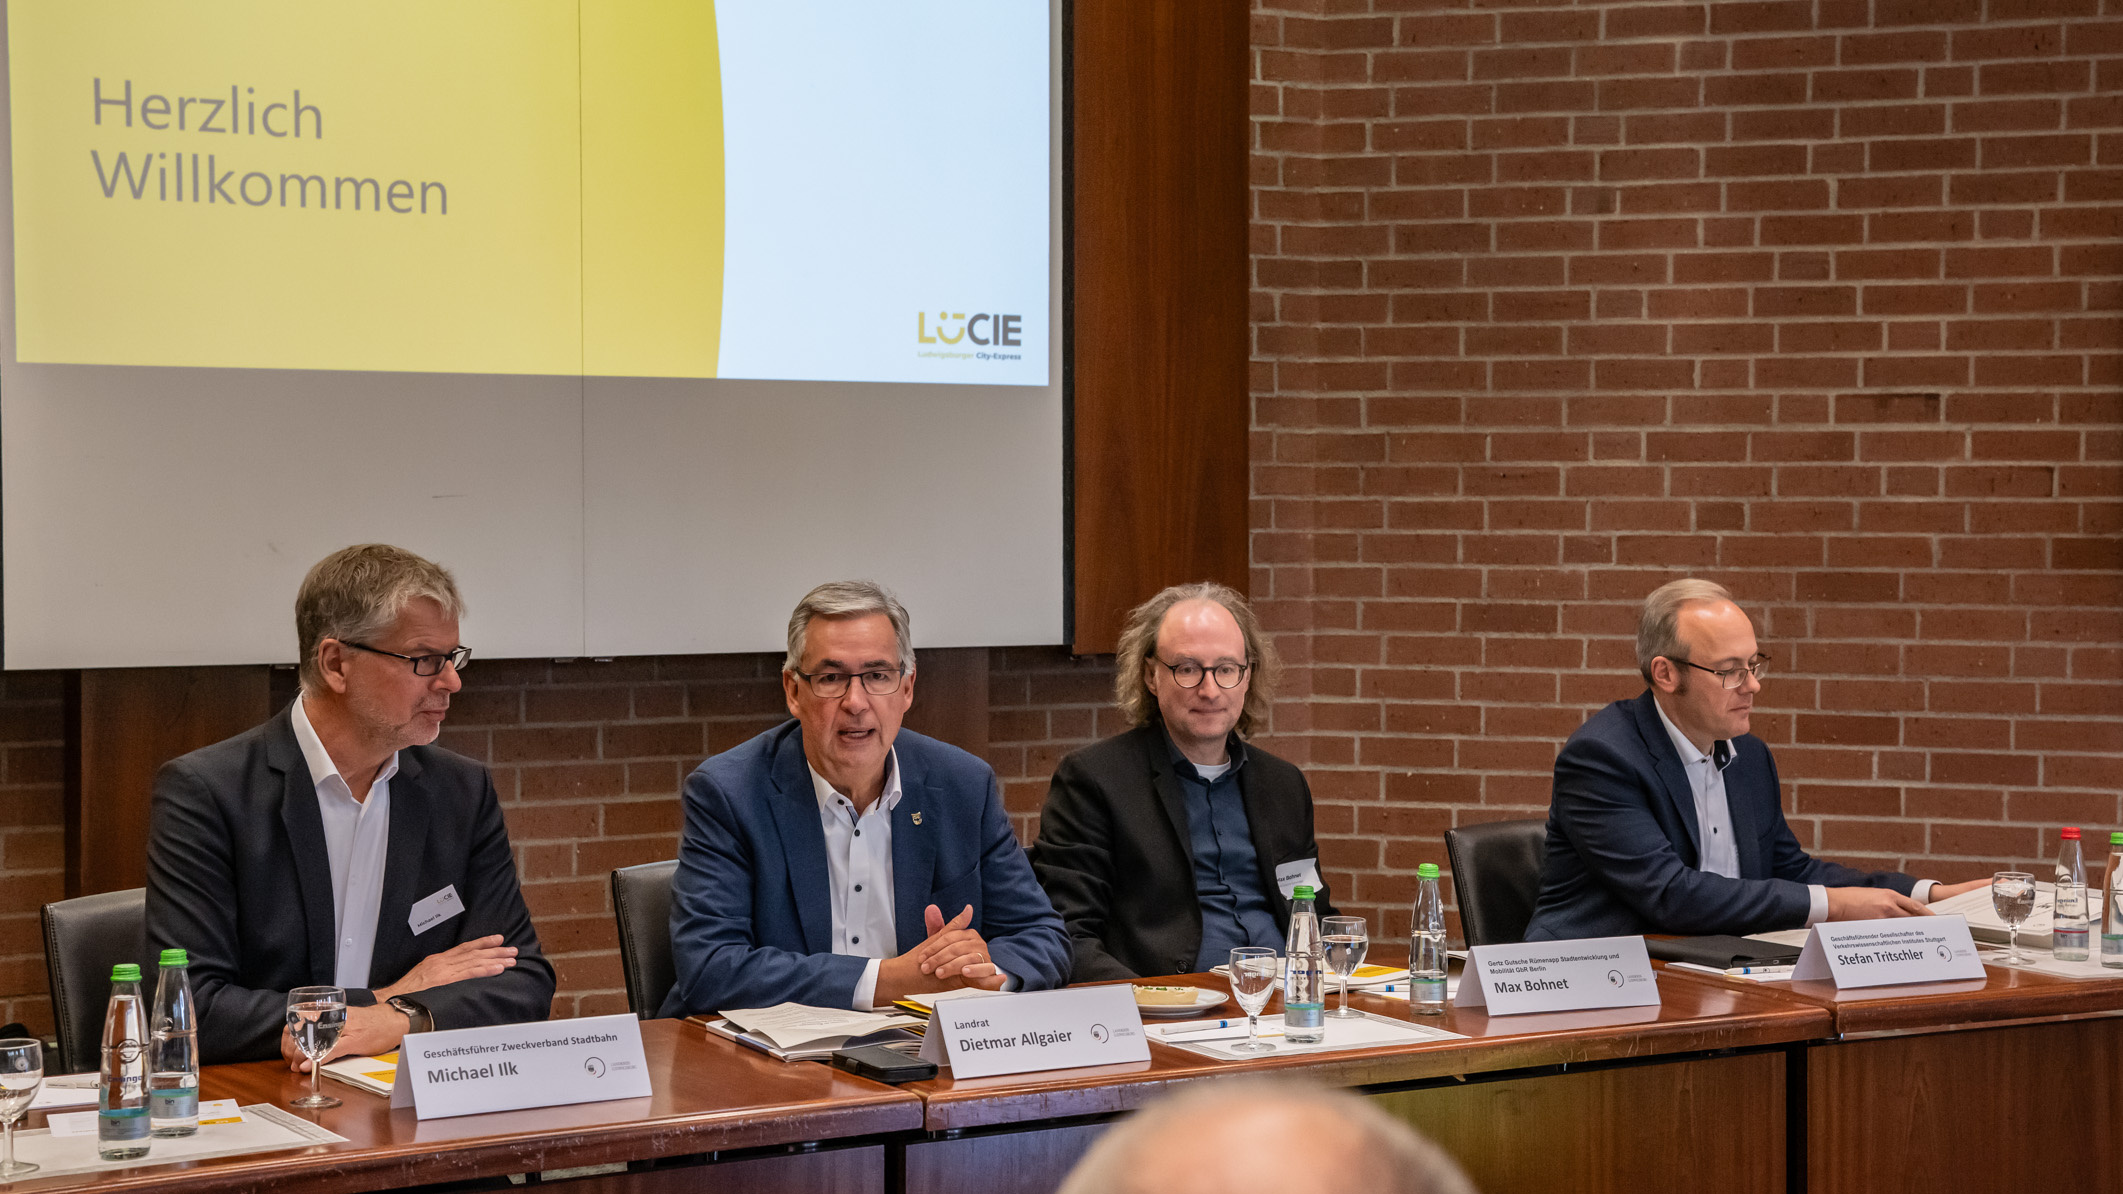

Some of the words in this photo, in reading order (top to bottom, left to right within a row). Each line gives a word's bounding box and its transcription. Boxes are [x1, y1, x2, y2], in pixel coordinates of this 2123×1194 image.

[93, 77, 323, 140] Herzlich
[90, 149, 448, 216] Willkommen
[975, 352, 1022, 361] City-Express
[1830, 933, 1879, 942] Geschäftsführender
[1879, 931, 1914, 939] Gesellschafter
[1901, 937, 1924, 945] Institutes
[1925, 936, 1946, 944] Stuttgart
[1504, 958, 1528, 966] Gutsche
[1560, 954, 1608, 963] Stadtentwicklung
[1838, 952, 1873, 966] Stefan
[1874, 949, 1924, 963] Tritschler
[1489, 967, 1514, 975] Mobilität
[1494, 981, 1522, 994] Max
[1525, 978, 1569, 992] Bohnet
[954, 1019, 990, 1030] Landrat
[423, 1044, 499, 1059] Geschäftsführer
[501, 1036, 569, 1051] Zweckverband
[571, 1033, 618, 1045] Stadtbahn
[959, 1035, 1017, 1052] Dietmar
[1021, 1030, 1073, 1047] Allgaier
[427, 1063, 494, 1083] Michael
[498, 1061, 519, 1077] Ilk
